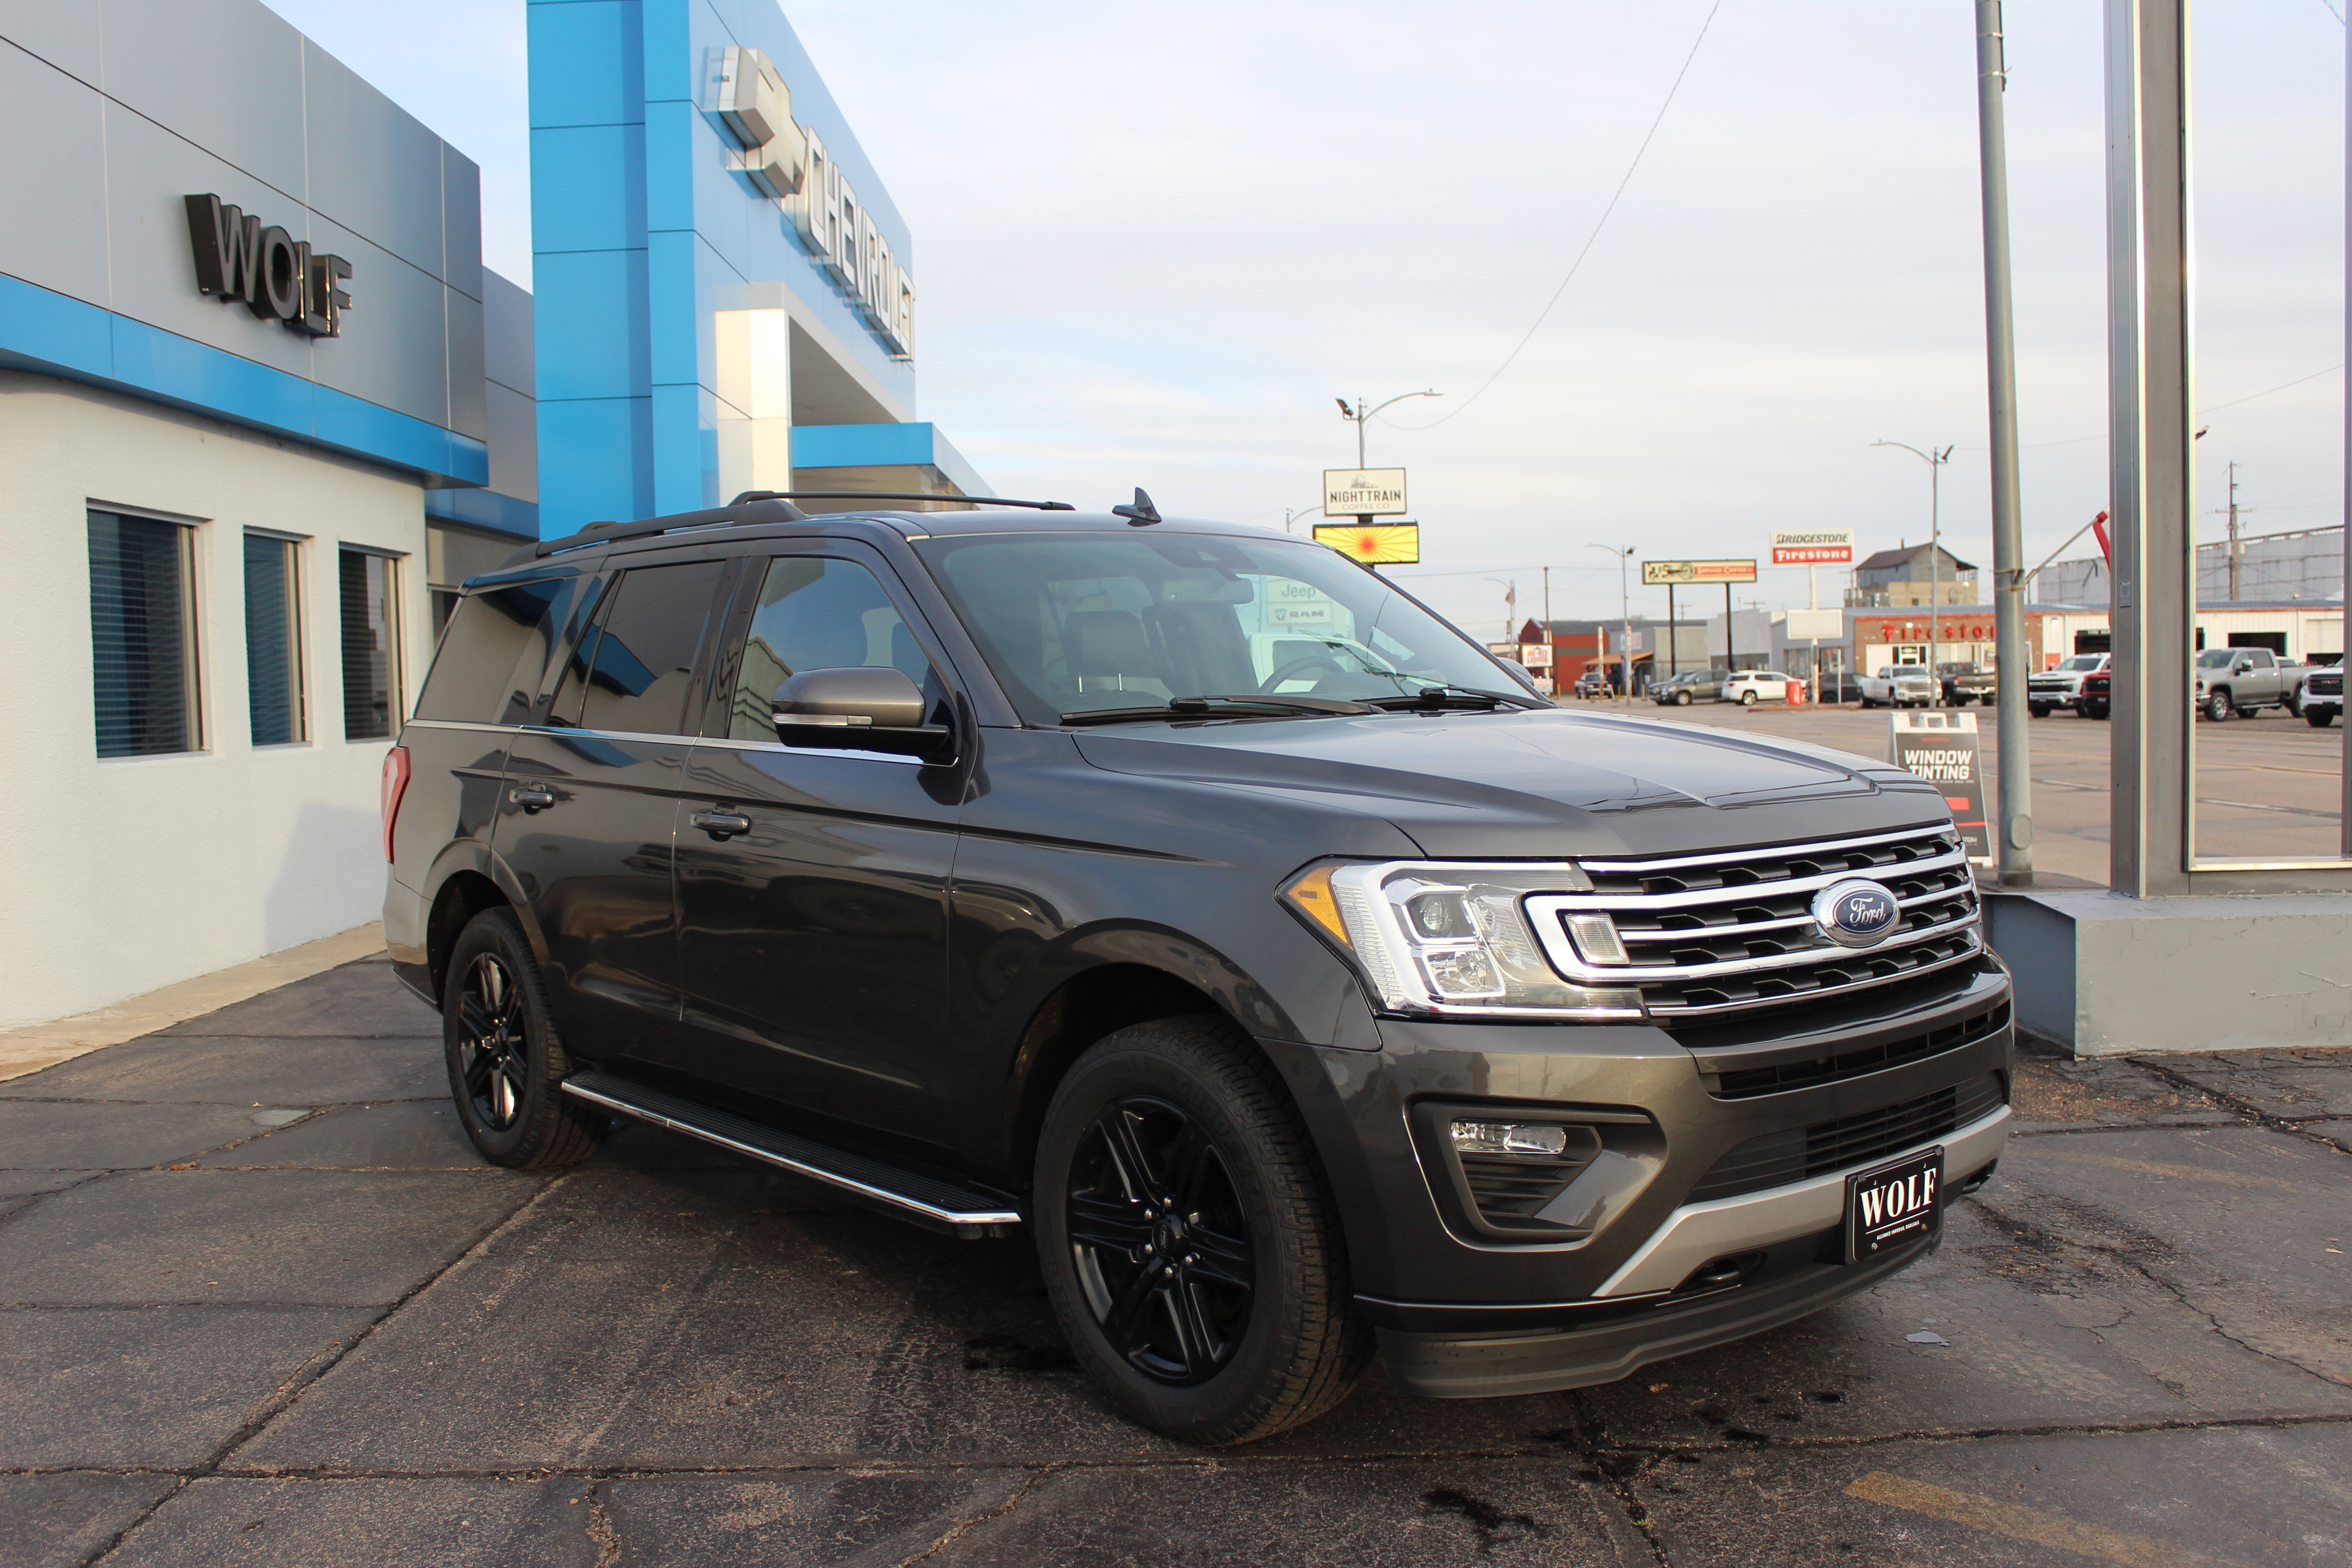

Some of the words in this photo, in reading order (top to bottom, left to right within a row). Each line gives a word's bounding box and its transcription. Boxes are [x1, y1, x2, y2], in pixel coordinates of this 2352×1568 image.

[803, 125, 916, 362] CHEVROLET
[185, 193, 353, 338] WOLF
[1330, 490, 1364, 502] NIGHT
[1366, 490, 1401, 501] TRAIN
[1776, 533, 1849, 544] BRIDGESTONE
[1776, 549, 1848, 562] Firestone
[1281, 583, 1316, 599] Jeep
[1904, 750, 1972, 764] WINDOW
[1909, 765, 1970, 779] TINTING
[1849, 897, 1886, 926] Ford
[1860, 1168, 1936, 1226] WOLF
[1877, 1230, 1891, 1240] ALLIANCE
[1891, 1226, 1905, 1235] IMPERIAL
[1905, 1220, 1920, 1230] OGALLALA
